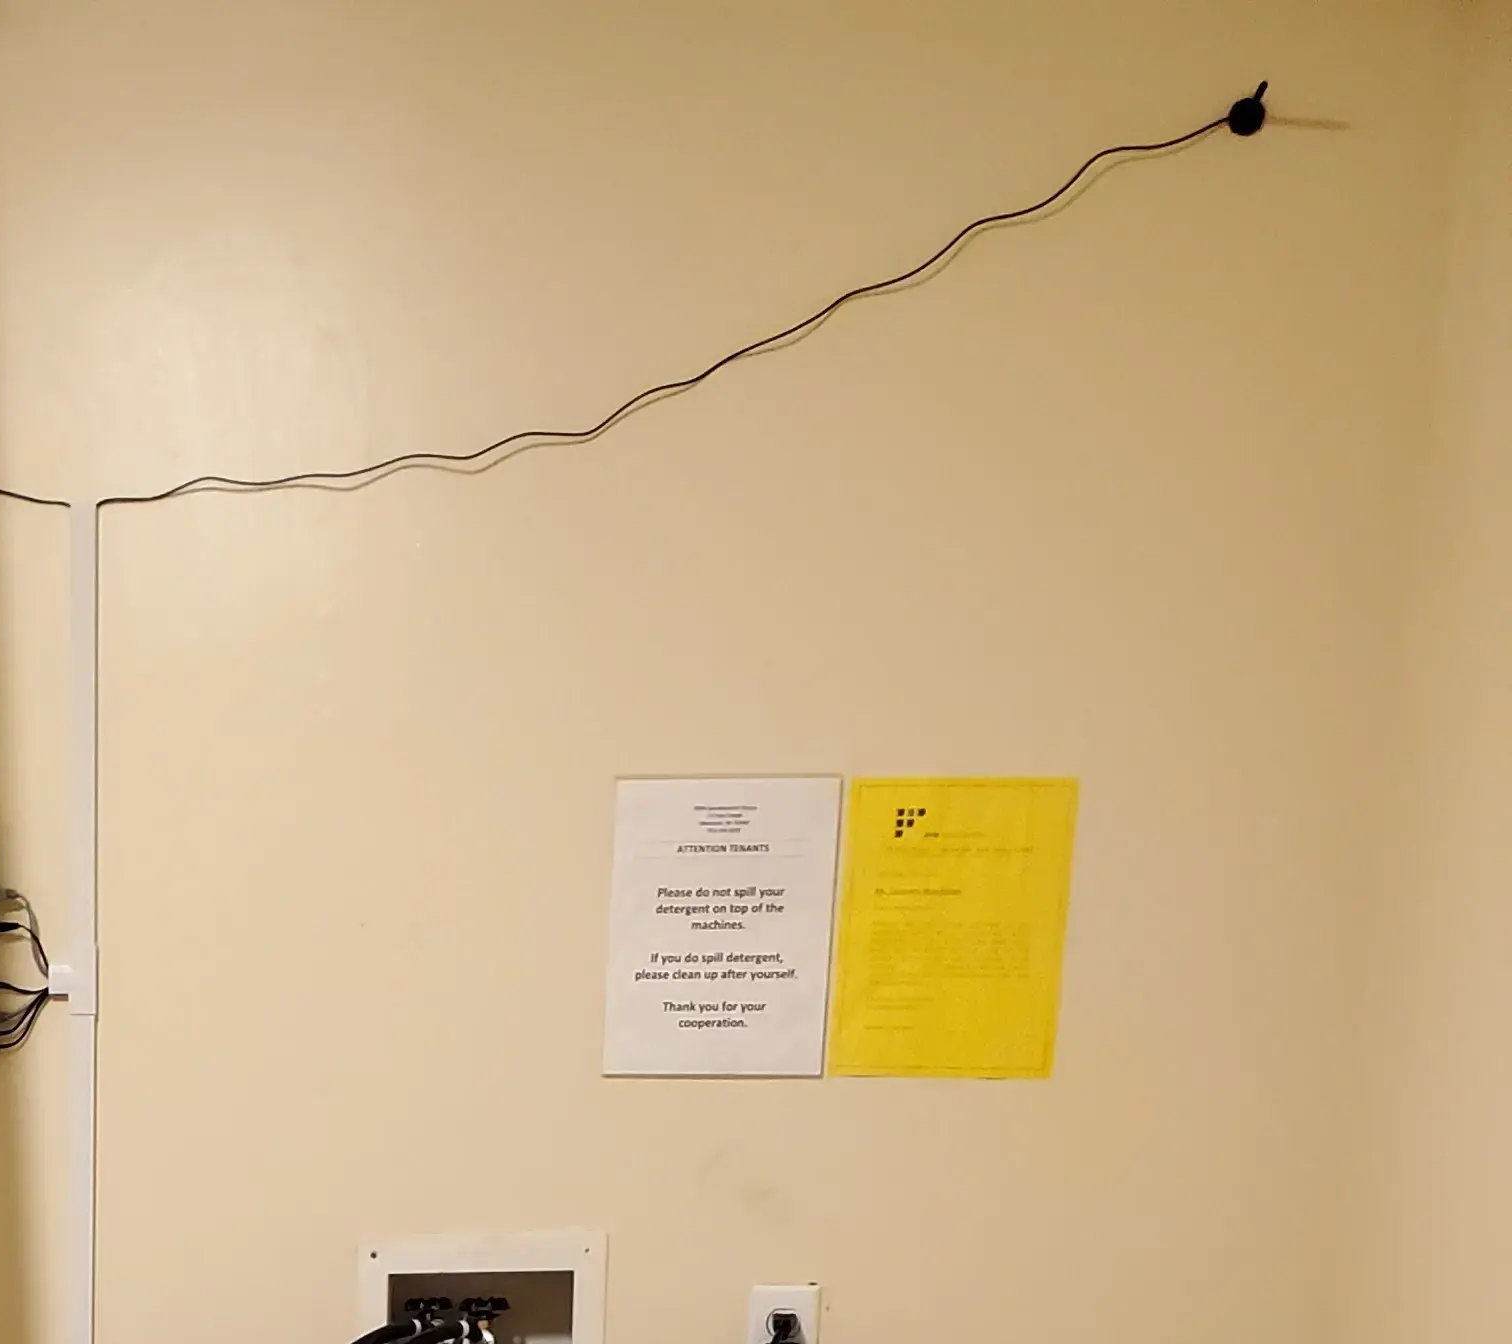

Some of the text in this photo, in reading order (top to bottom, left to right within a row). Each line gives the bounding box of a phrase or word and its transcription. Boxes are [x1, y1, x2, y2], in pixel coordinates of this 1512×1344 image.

[676, 843, 770, 854] ATTENTION TENANTS
[656, 886, 786, 901] Please do not spill your
[655, 903, 784, 916] detergent on top of the
[691, 918, 746, 930] machines.
[650, 952, 784, 966] If you do spill detergent,
[634, 968, 799, 982] please clean up after yourself.
[662, 1001, 767, 1014] Thank you for your
[678, 1017, 749, 1030] cooperation.
